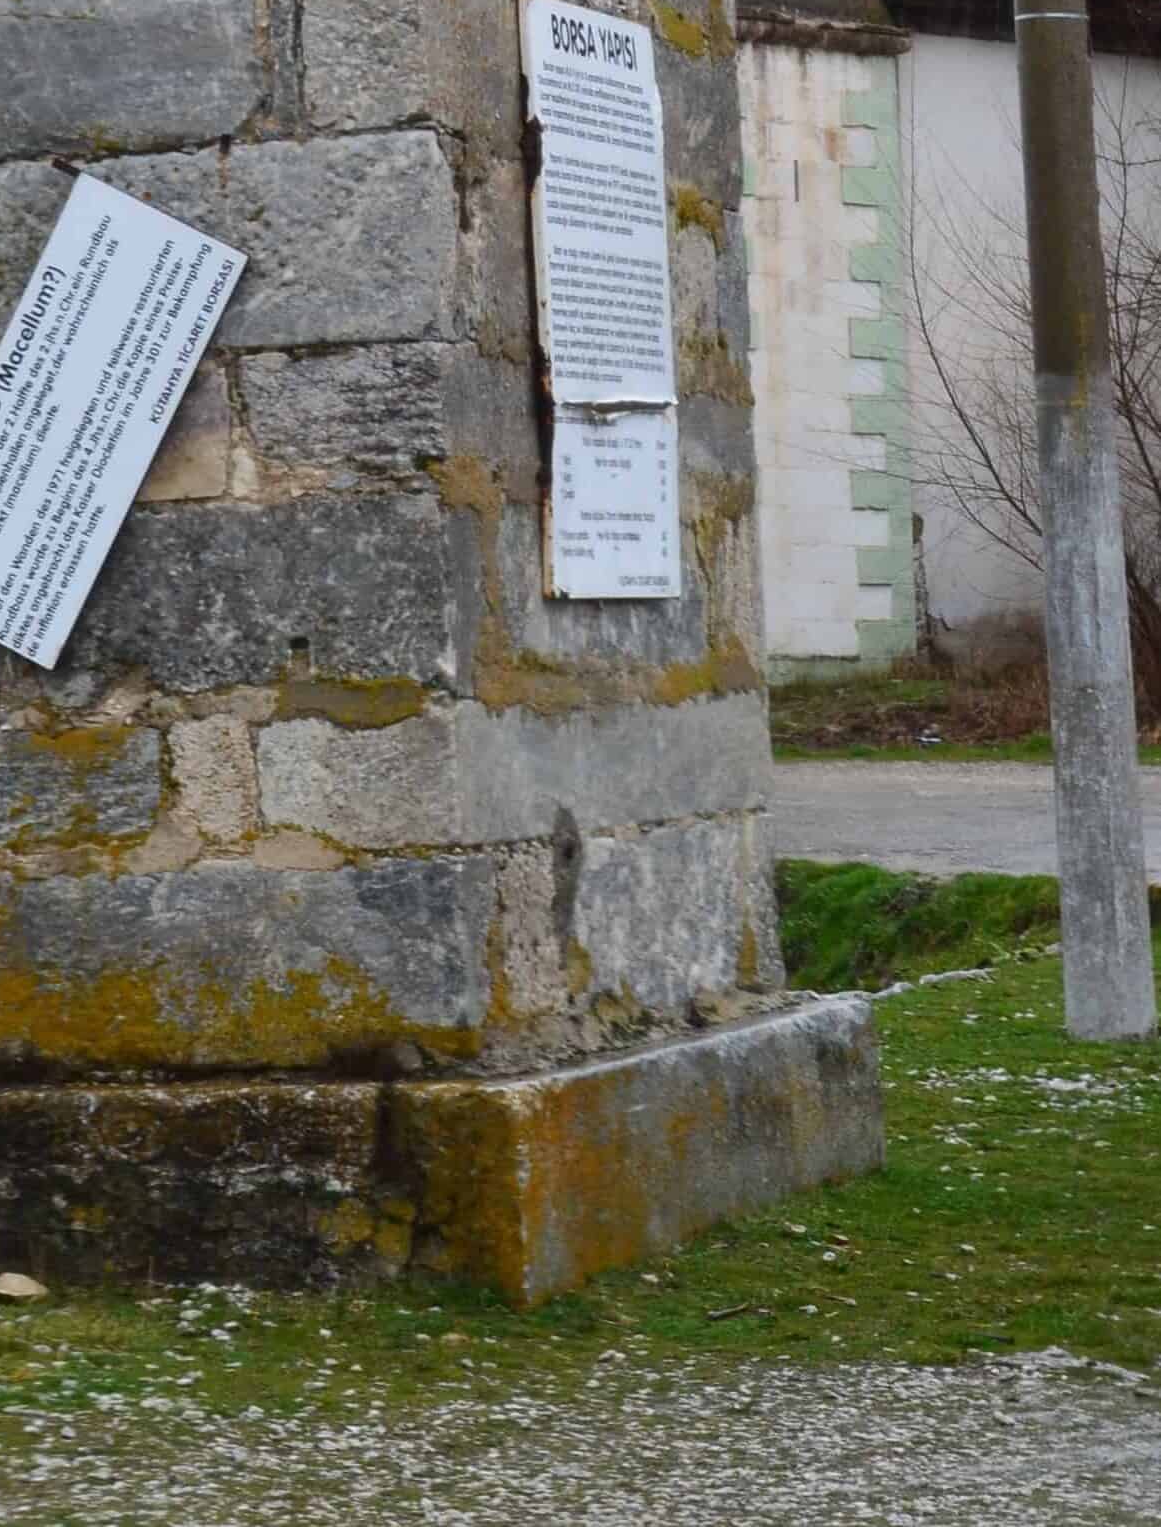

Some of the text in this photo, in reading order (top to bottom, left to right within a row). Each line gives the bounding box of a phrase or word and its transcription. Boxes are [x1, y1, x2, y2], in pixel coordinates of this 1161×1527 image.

[551, 14, 638, 72] BORSA YAPISI
[26, 354, 46, 379] des
[78, 212, 113, 269] Rundbau
[60, 256, 109, 346] wahrscheinlich
[102, 236, 119, 258] als
[147, 364, 185, 425] KÜTAHYA
[200, 257, 235, 314] BORSASI
[0, 571, 17, 597] den
[35, 496, 53, 521] des
[46, 467, 67, 496] 1971
[59, 395, 103, 470] freigelegten
[93, 370, 113, 396] und
[106, 315, 138, 370] teilweise
[131, 237, 175, 316] restaurierten
[2, 442, 43, 511] (macellum)
[10, 612, 35, 650] diktes
[72, 479, 98, 519] Kaiser
[91, 418, 127, 480] Diocletian
[119, 399, 136, 419] im
[128, 364, 152, 401] Jahre
[145, 341, 163, 365] 301
[156, 318, 174, 342] zur
[24, 541, 50, 582] wurde
[43, 524, 58, 542] zu
[51, 480, 81, 526] Beginn
[71, 457, 90, 482] des
[124, 332, 151, 371] Kopie
[142, 298, 165, 333] eines
[25, 639, 41, 658] de
[33, 589, 65, 640] Inflation
[57, 537, 89, 590] erlassen
